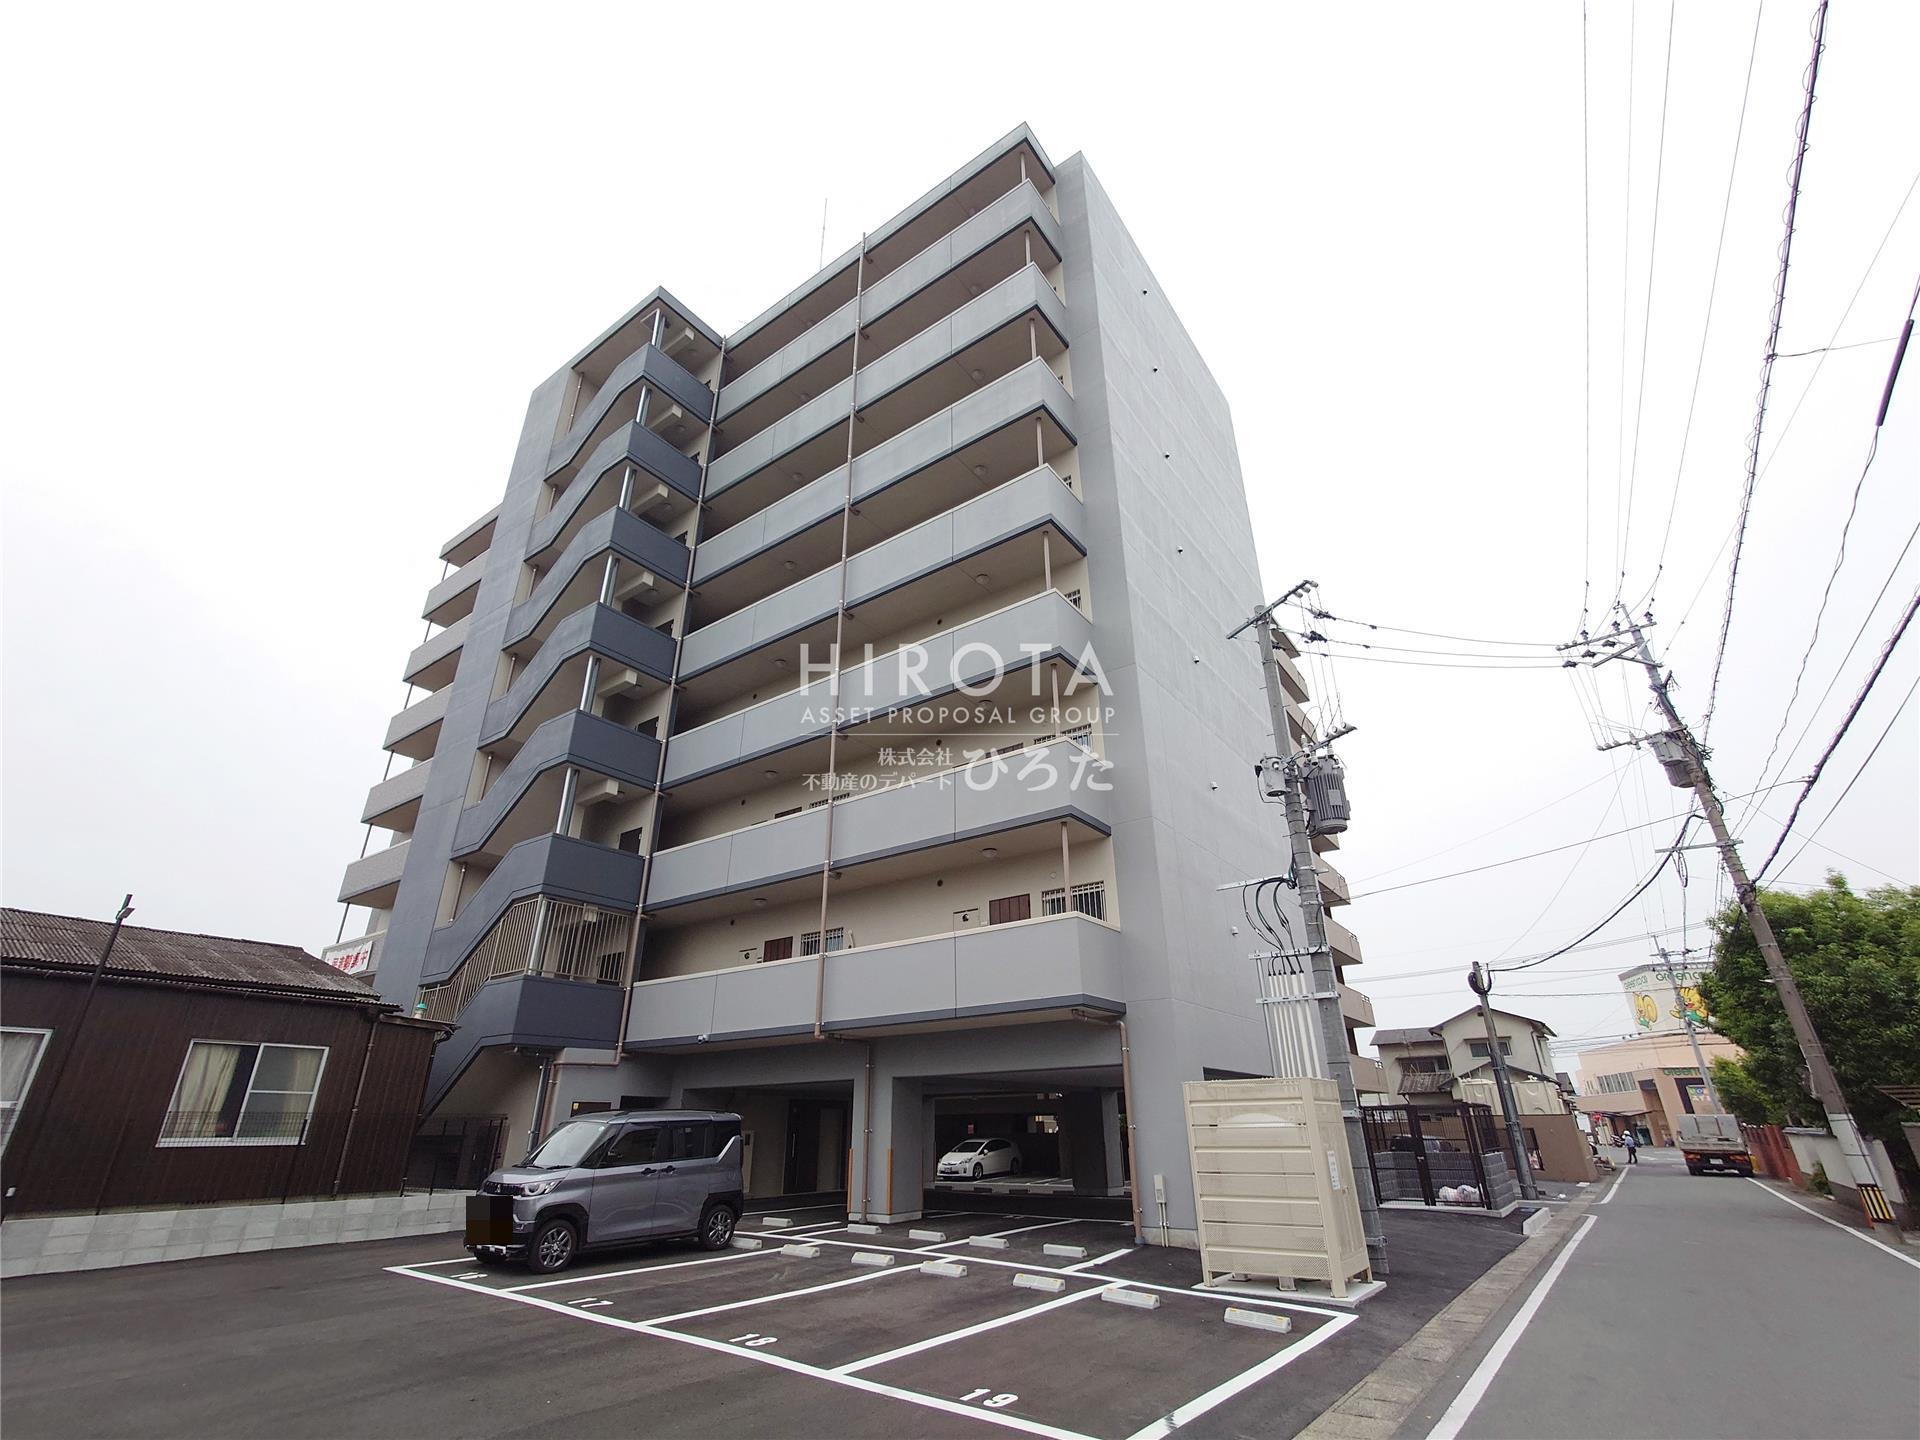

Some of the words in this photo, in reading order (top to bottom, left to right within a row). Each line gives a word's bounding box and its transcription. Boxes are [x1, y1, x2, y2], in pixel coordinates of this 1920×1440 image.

[568, 1297, 614, 1308] 17
[729, 1333, 778, 1347] 18
[959, 1388, 1019, 1408] 19
